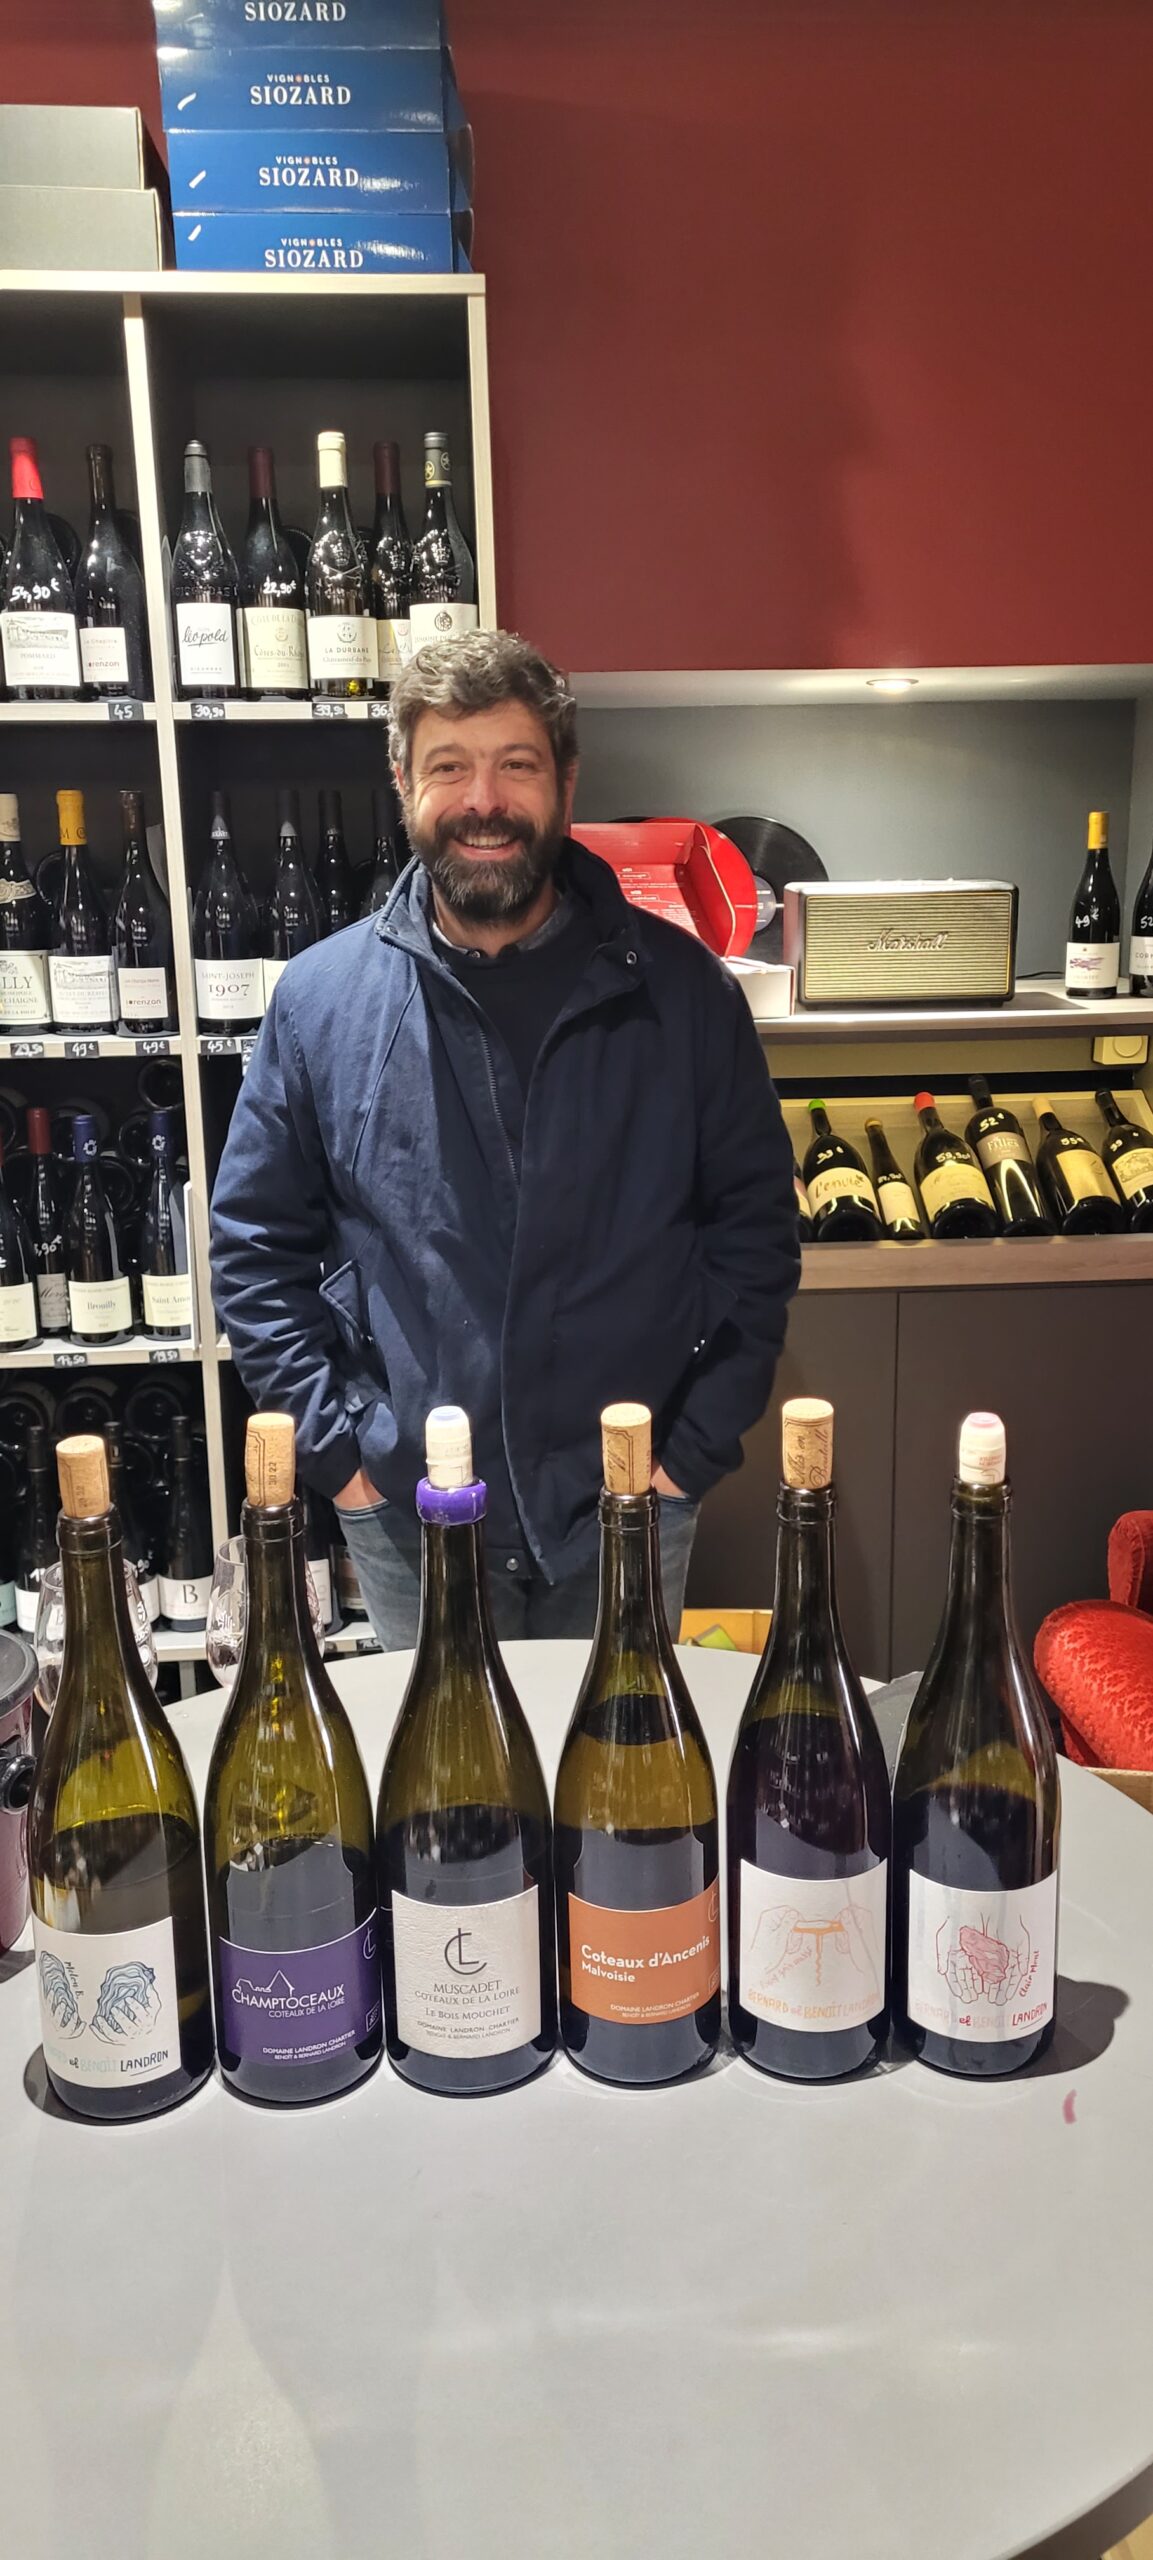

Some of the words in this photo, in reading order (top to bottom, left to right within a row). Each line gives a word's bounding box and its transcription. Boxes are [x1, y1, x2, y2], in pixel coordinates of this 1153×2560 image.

[244, 2, 347, 22] SIOZARD
[250, 85, 352, 105] SIOZARD
[259, 167, 359, 187] SIOZARD
[264, 248, 364, 268] SIOZARD
[113, 704, 133, 720] 45
[867, 927, 949, 952] Marshall
[1, 976, 32, 990] LLY
[208, 983, 250, 997] 1907
[183, 1584, 198, 1604] B
[581, 1944, 645, 1969] Coteaux
[648, 1935, 710, 1968] d'Ancenis
[581, 1961, 636, 1983] Malvoisie
[231, 1983, 345, 2010] CHAMPTOCEAUX
[414, 1990, 460, 2005] COTEAUX
[462, 1997, 475, 2005] DE
[478, 1994, 491, 2003] LA
[493, 1986, 520, 2001] LOIRE
[433, 1979, 502, 1995] MUSCADET
[268, 2010, 304, 2018] COTEAUX
[306, 2007, 316, 2015] DE
[318, 2005, 326, 2013] LA
[328, 1997, 345, 2010] LOIRE
[610, 2004, 641, 2013] DOMAINE
[641, 2003, 674, 2012] LANDRON
[674, 1992, 700, 2007] CHARTIER
[1012, 2001, 1048, 2026] LANDRON
[416, 2020, 446, 2032] DOMAINE
[450, 2026, 484, 2034] LANDRON
[488, 2017, 520, 2030] CHARTIER
[294, 2042, 327, 2054] LANDRON
[328, 2029, 356, 2046] CHARTIER
[322, 2041, 346, 2054] LANDRON
[120, 2050, 169, 2073] LANDRON
